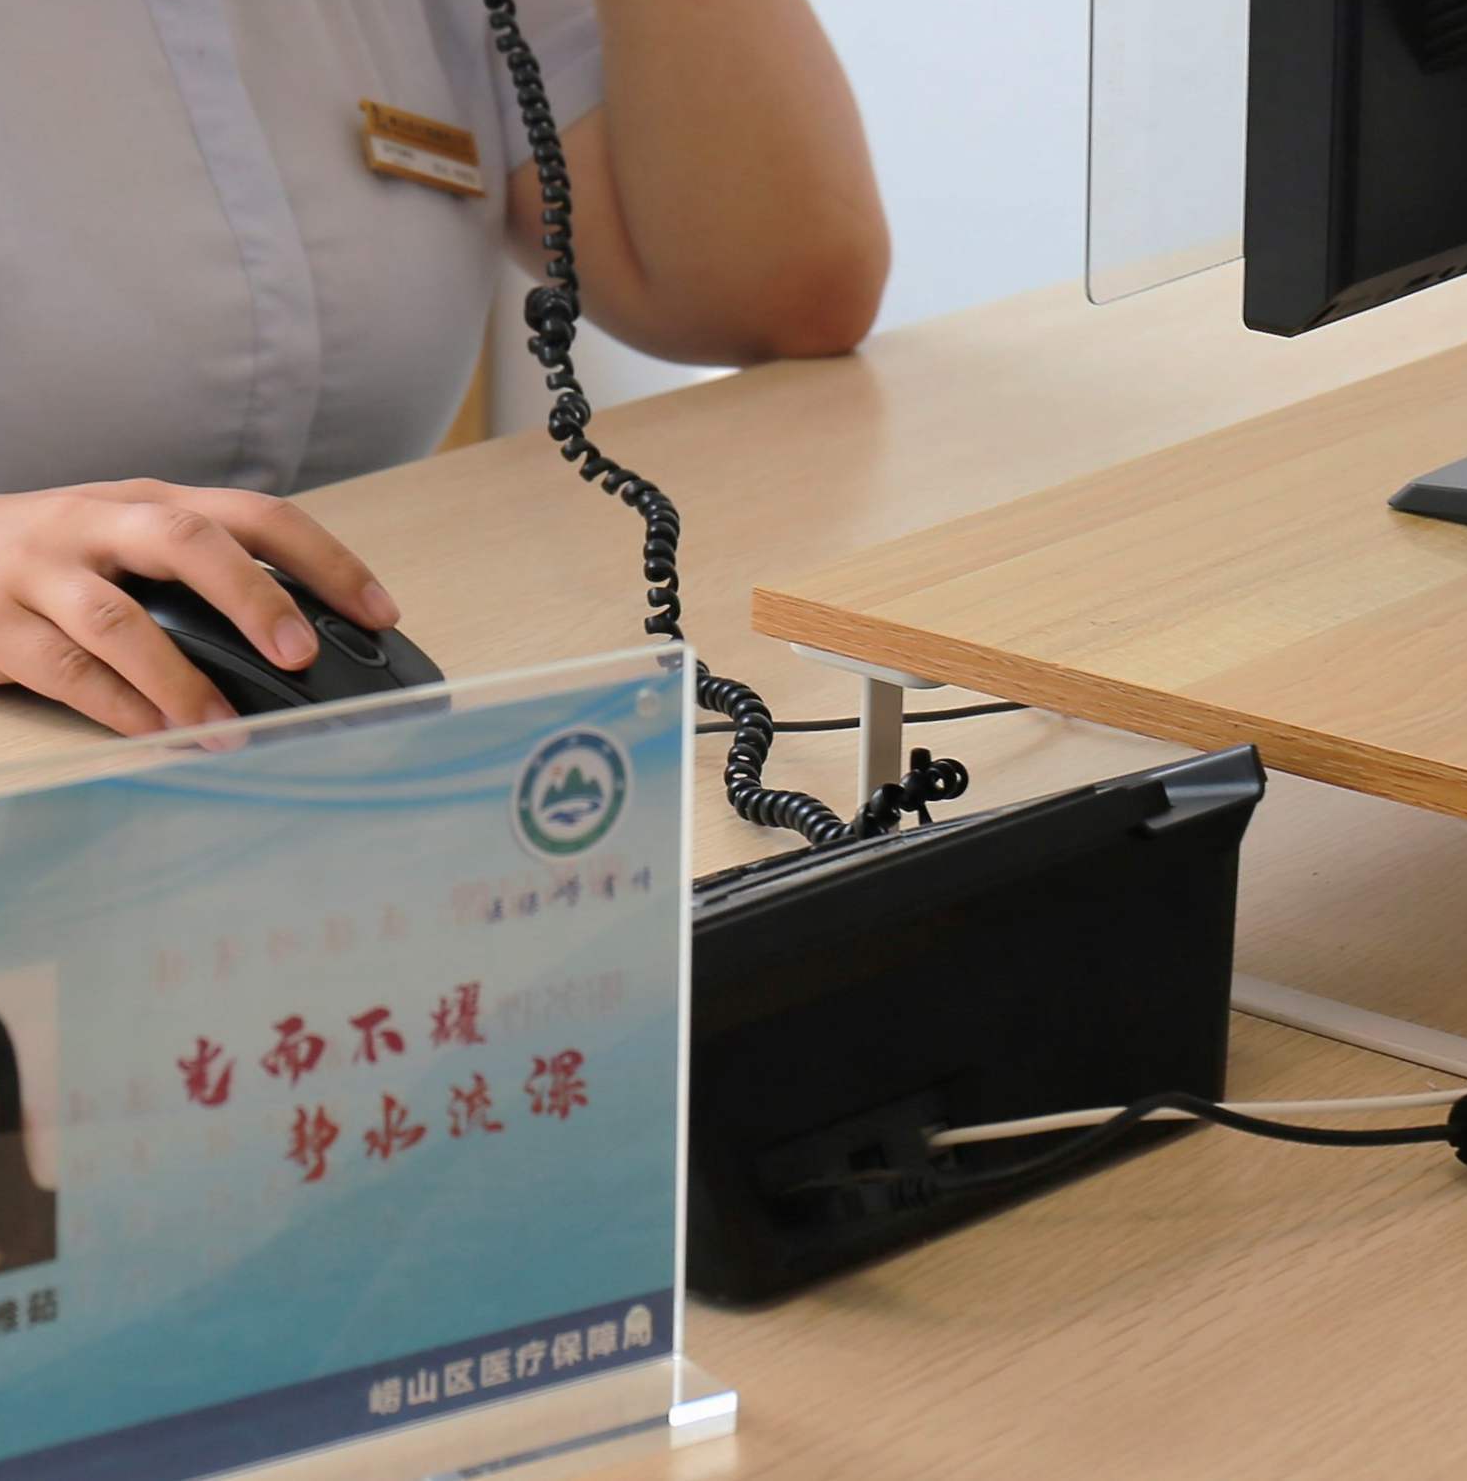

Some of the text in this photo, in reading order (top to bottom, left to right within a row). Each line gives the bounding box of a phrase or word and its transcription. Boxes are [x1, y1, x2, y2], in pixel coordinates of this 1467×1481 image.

[178, 982, 486, 1108] 光而不耀
[285, 1049, 589, 1184] 静水流深
[368, 1304, 653, 1415] 崂山区医疗保障局
